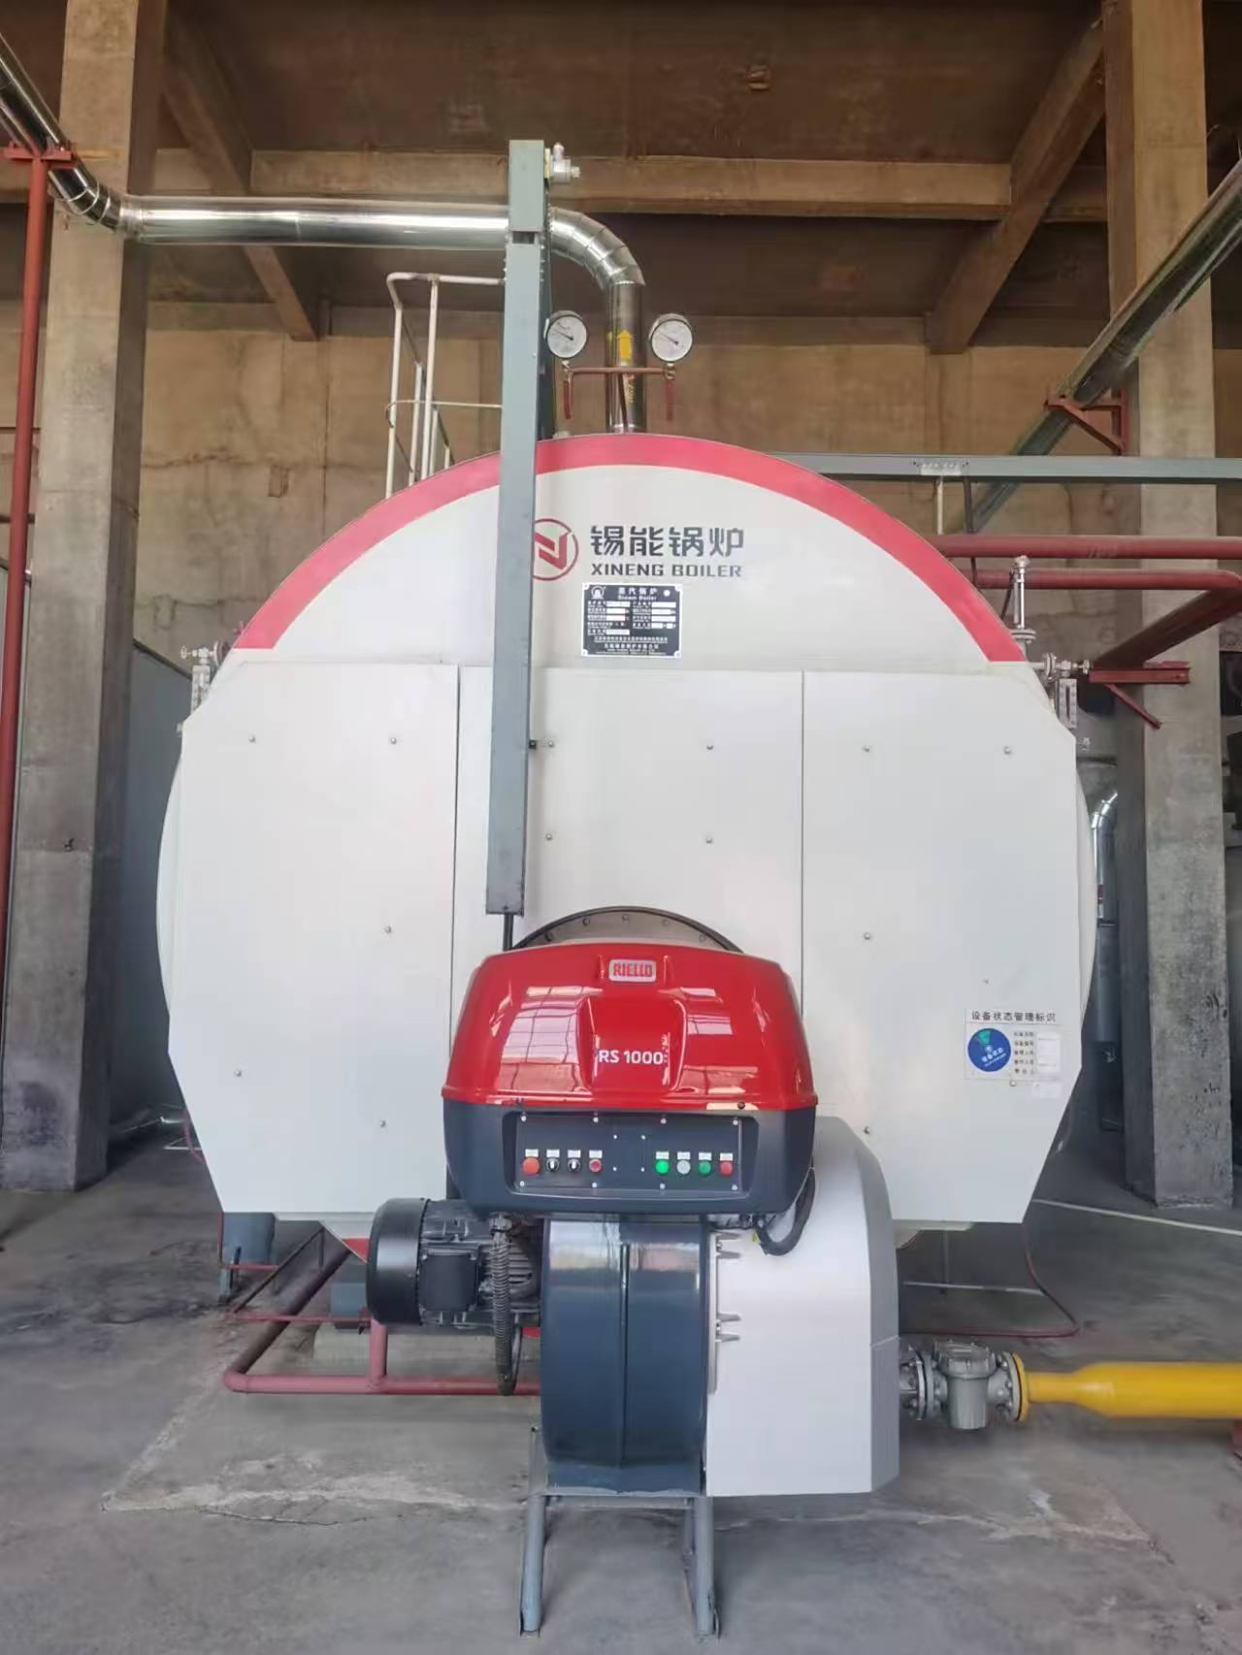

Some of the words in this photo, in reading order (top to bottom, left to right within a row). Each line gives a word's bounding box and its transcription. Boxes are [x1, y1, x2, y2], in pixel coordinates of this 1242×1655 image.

[590, 525, 745, 557] 锡能锅炉
[591, 563, 665, 577] XINENG
[671, 563, 743, 578] BOILER
[613, 962, 653, 978] RIELLO
[971, 1010, 1056, 1022] 设备状态管理标识
[598, 1049, 619, 1064] RS
[623, 1050, 664, 1065] 1000
